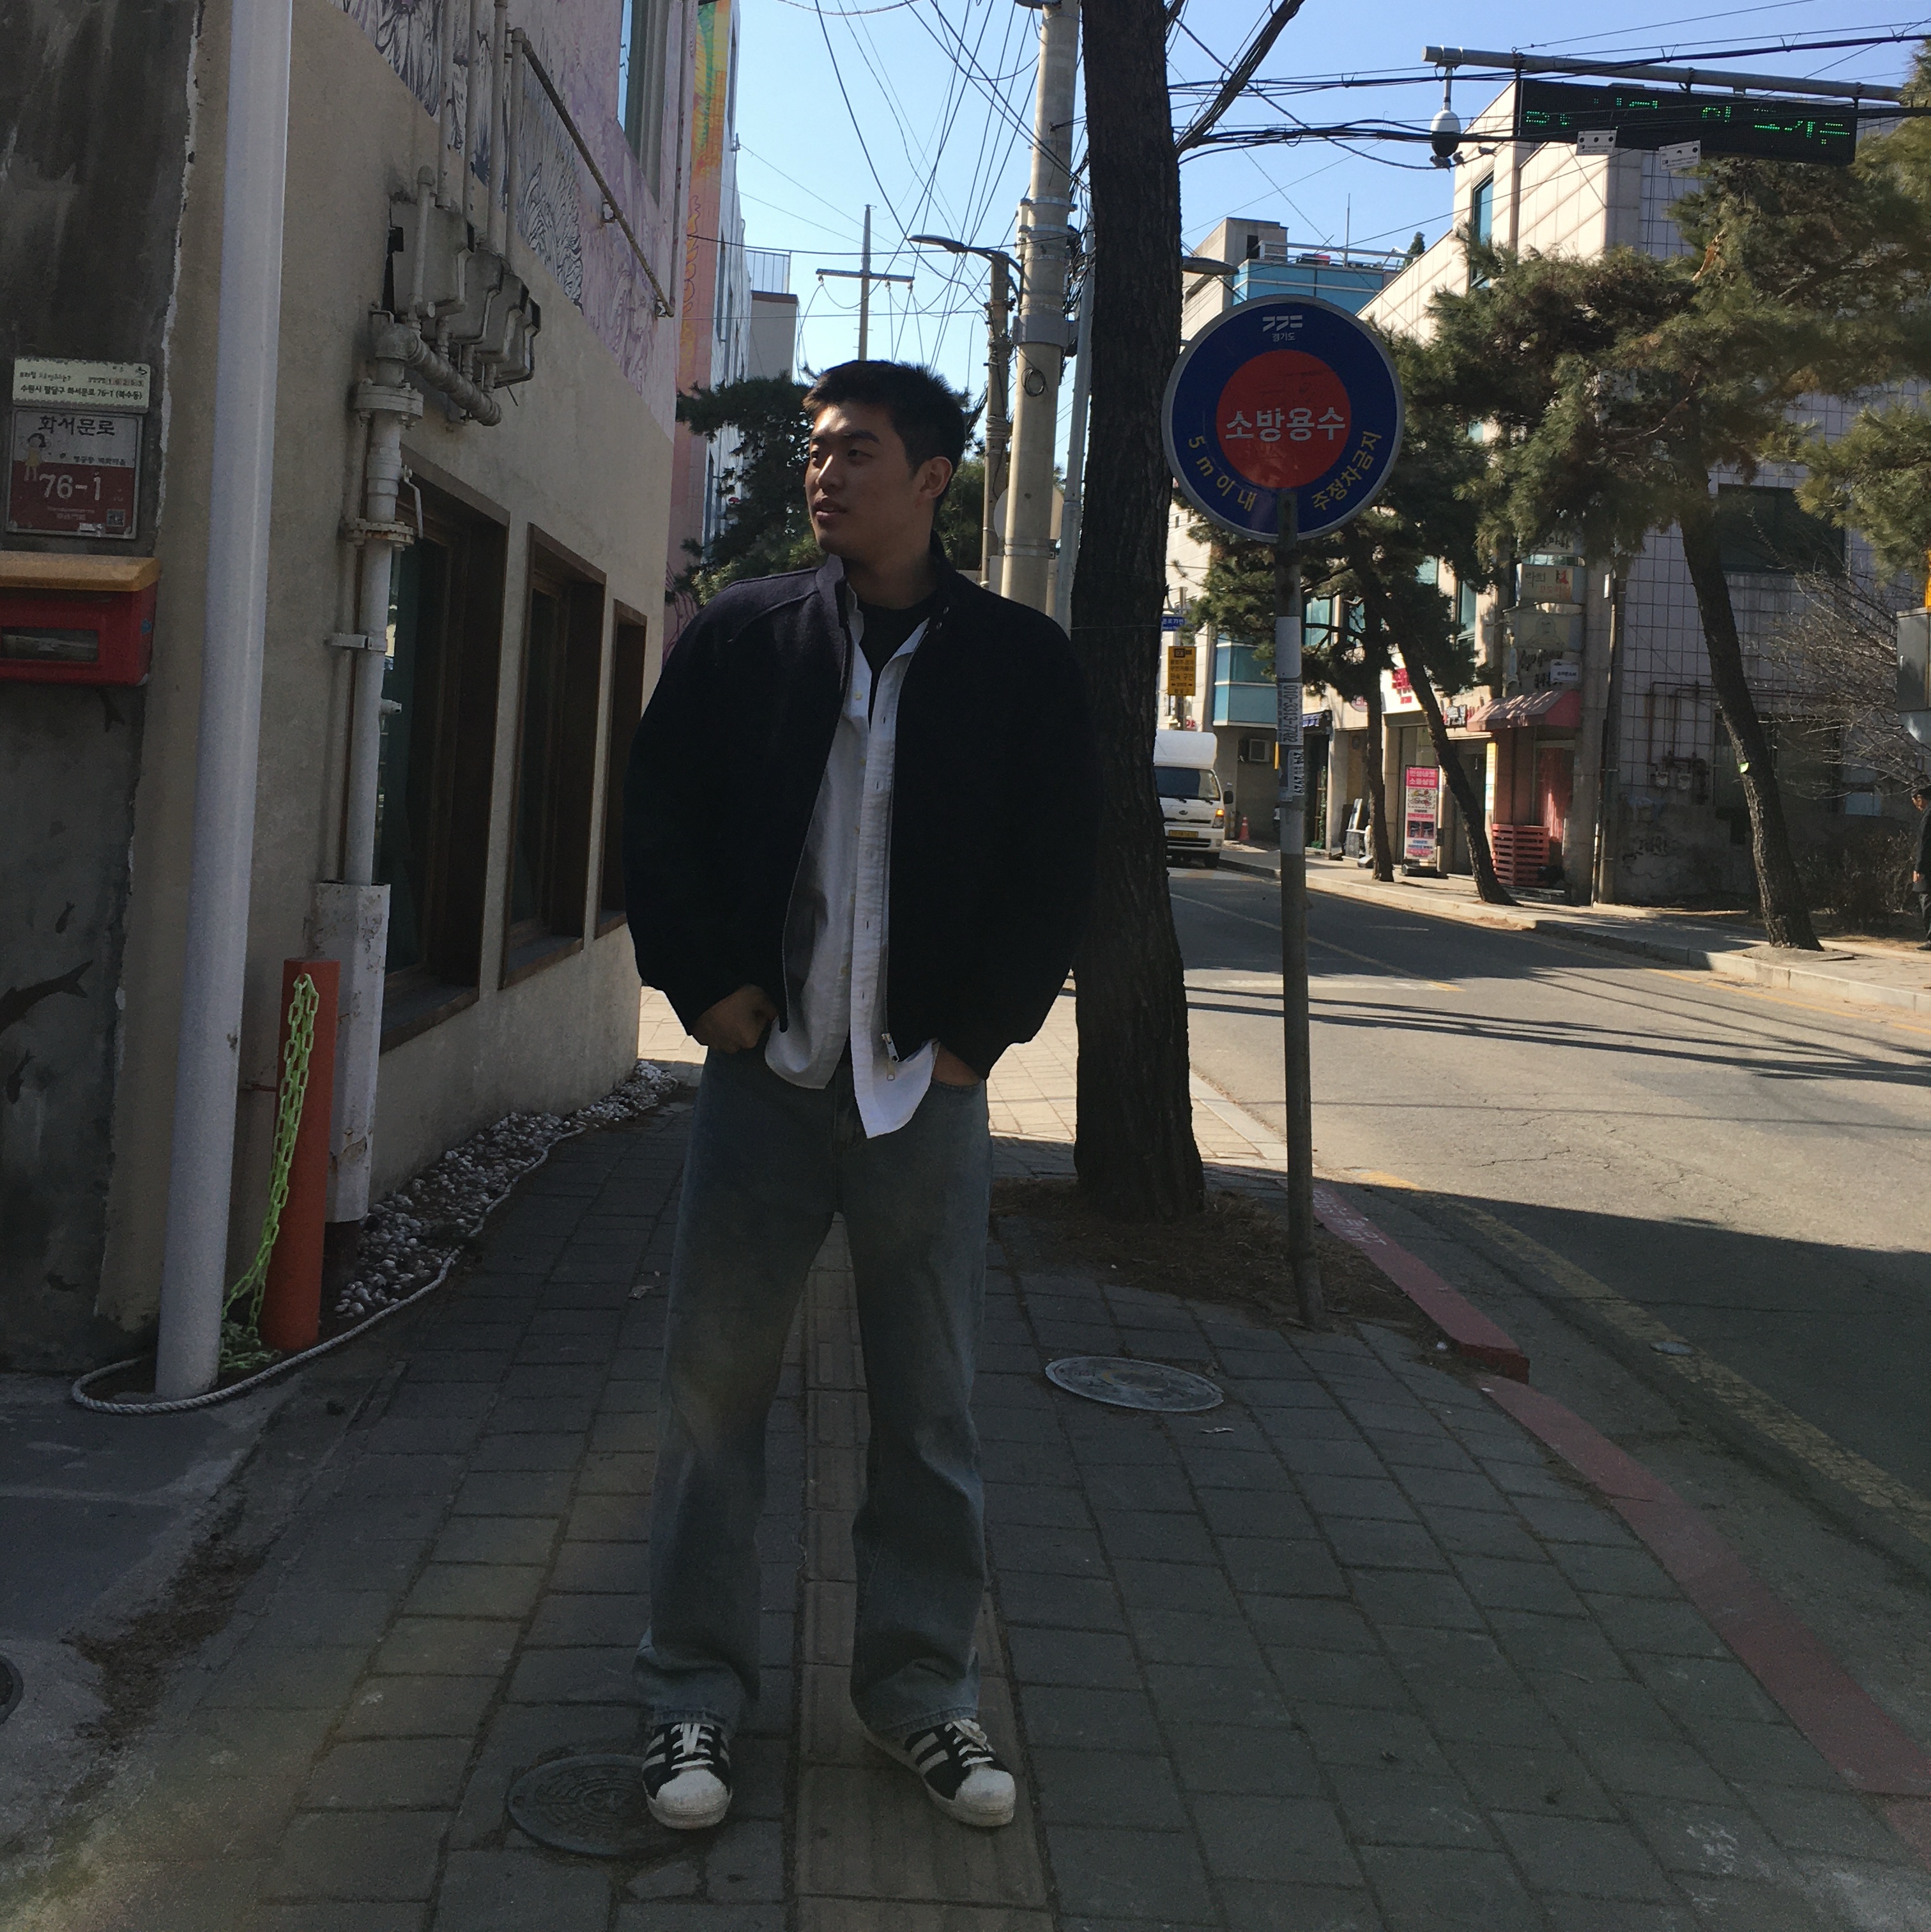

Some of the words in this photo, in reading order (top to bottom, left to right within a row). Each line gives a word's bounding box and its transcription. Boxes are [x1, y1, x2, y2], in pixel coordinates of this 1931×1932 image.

[1272, 332, 1296, 342] 경기도
[20, 385, 42, 394] 수원시
[44, 385, 65, 395] 팔달구
[67, 387, 95, 396] 화서문로
[97, 389, 113, 397] 76-1
[38, 415, 115, 436] 화서문로
[1225, 407, 1346, 442] 소방용수
[1311, 431, 1382, 510] 주정차금지
[39, 473, 102, 501] 76-1
